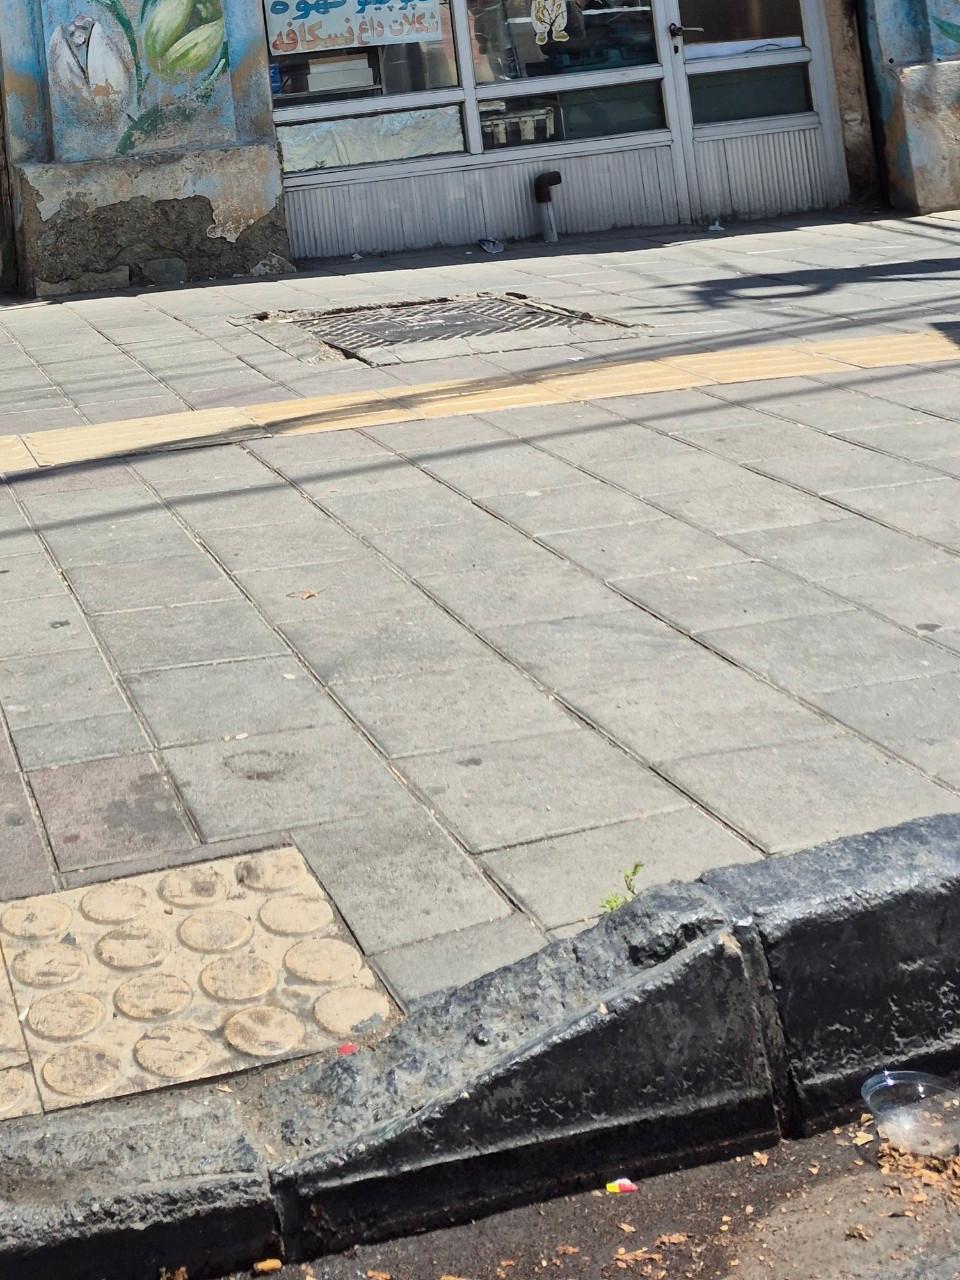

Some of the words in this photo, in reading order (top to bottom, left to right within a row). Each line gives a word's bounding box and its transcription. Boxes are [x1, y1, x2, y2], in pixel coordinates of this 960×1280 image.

[271, 16, 355, 52] نسکافه
[357, 15, 385, 46] داغ
[388, 11, 440, 38] شکلات
